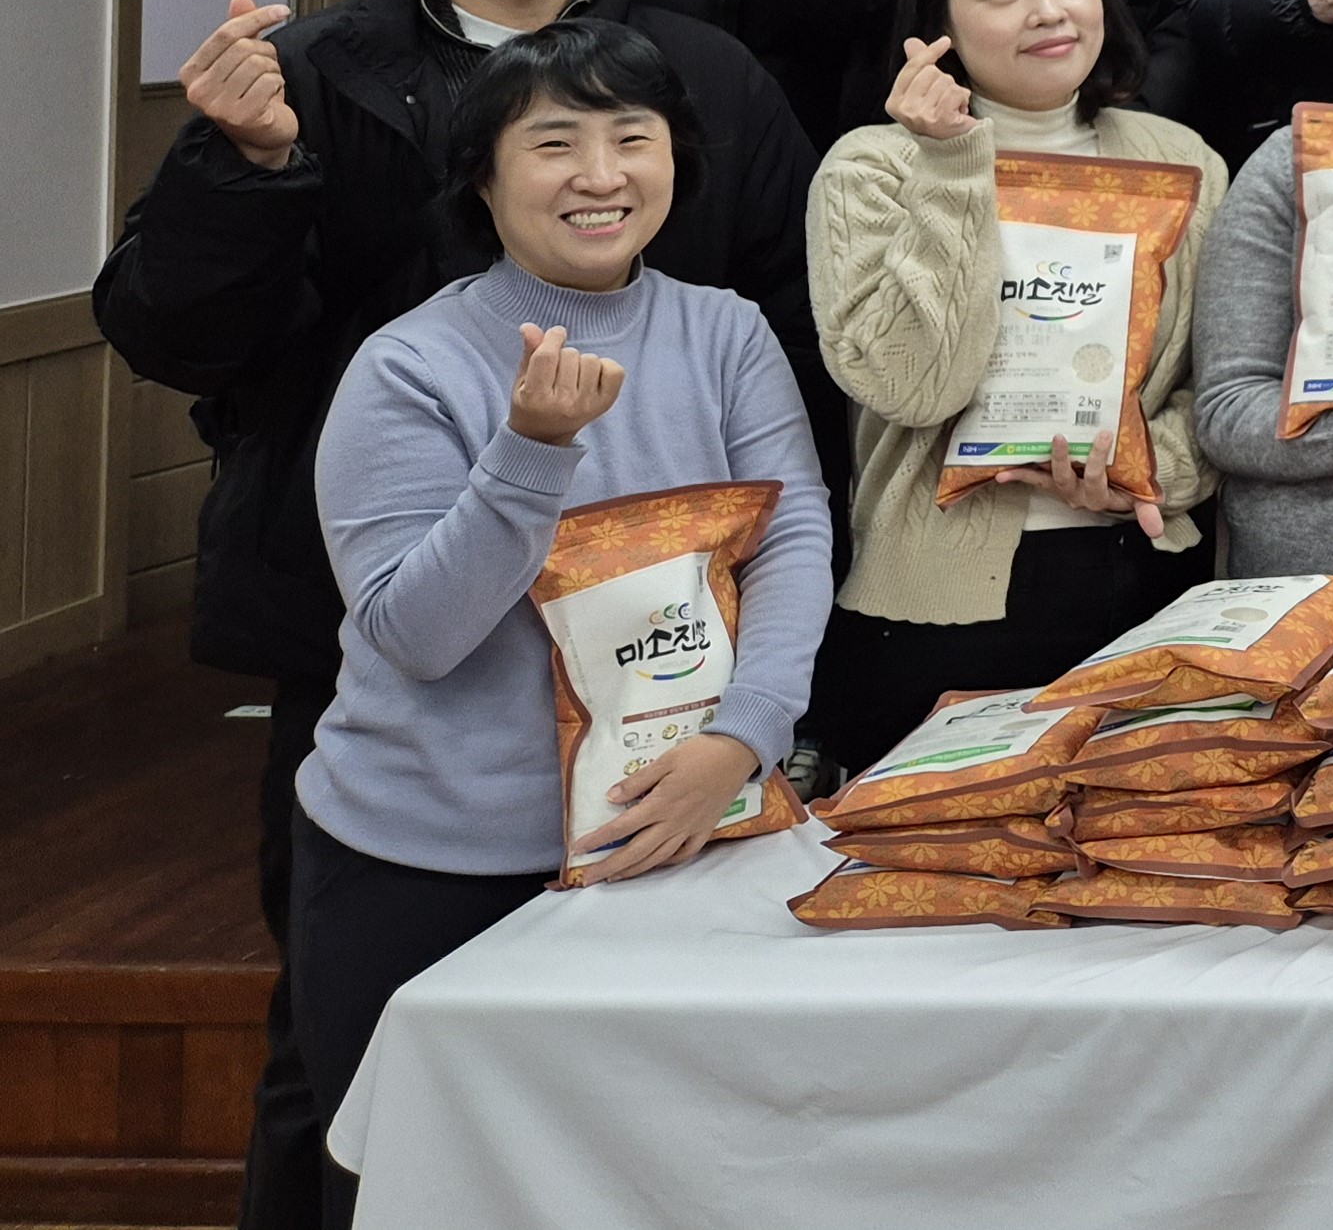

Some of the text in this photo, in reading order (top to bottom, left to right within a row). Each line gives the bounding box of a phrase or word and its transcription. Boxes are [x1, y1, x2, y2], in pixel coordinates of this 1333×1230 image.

[1000, 276, 1106, 306] 미소진쌀
[1077, 395, 1086, 408] 2
[1088, 396, 1102, 410] kg
